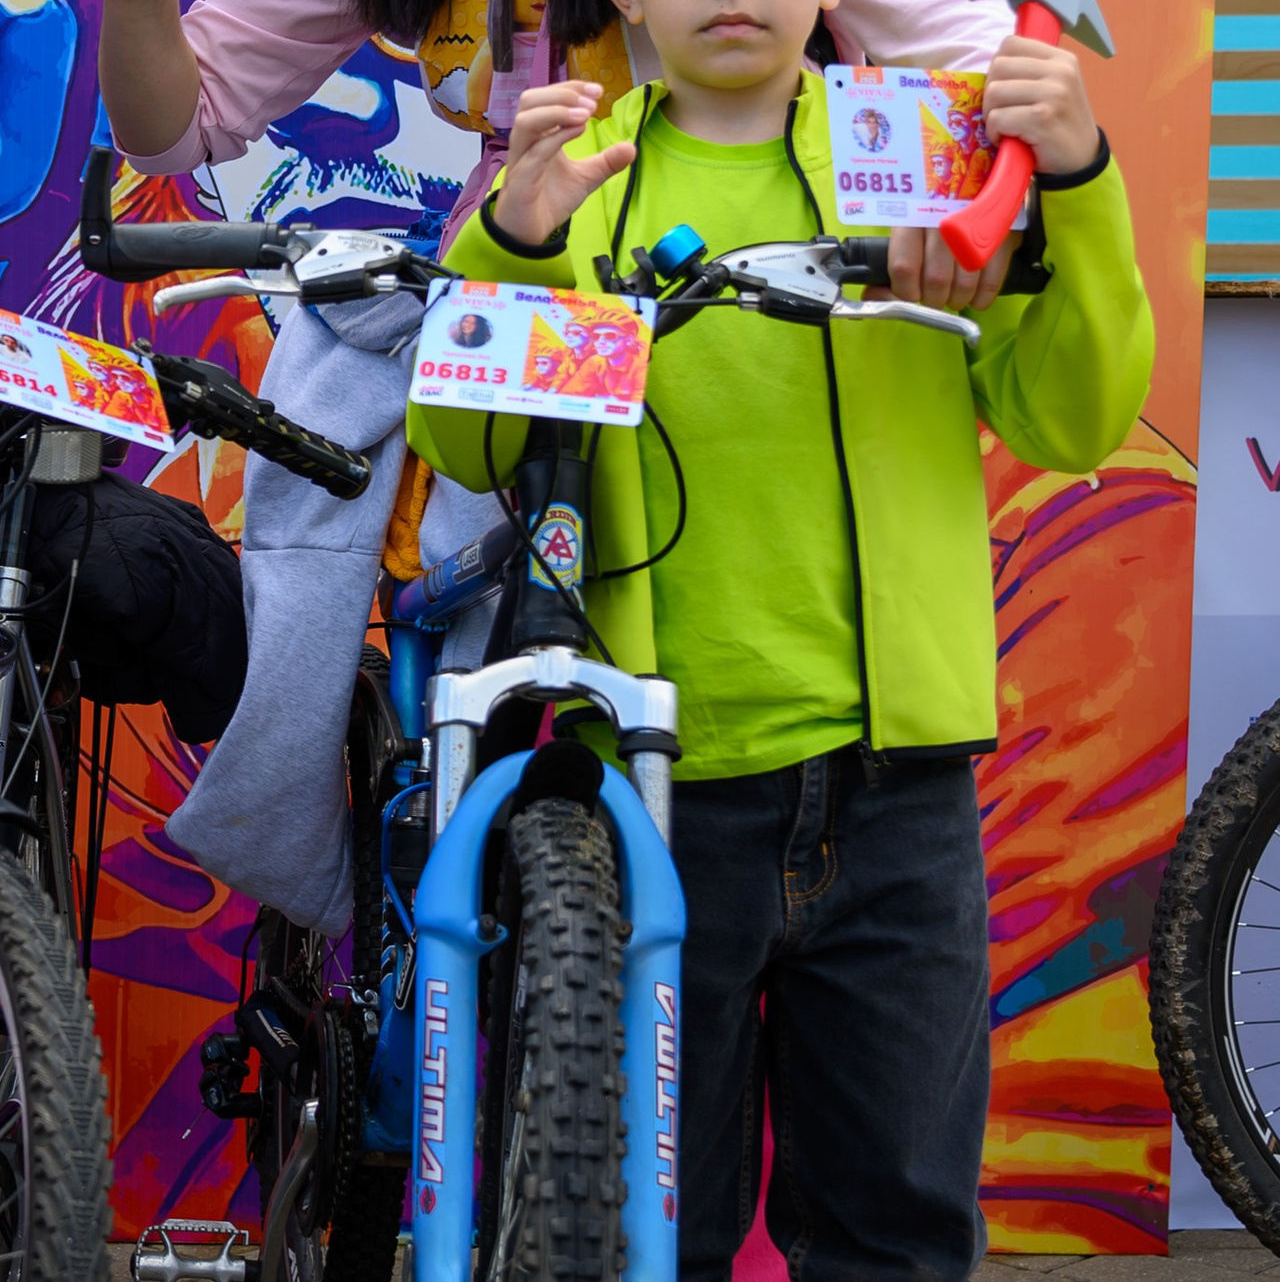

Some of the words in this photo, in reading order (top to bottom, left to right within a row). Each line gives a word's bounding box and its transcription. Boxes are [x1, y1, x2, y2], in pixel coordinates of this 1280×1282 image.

[839, 172, 913, 194] 06815
[420, 361, 508, 384] 06813
[420, 979, 449, 1184] ULTIMA
[654, 981, 677, 1189] ULTIMA
